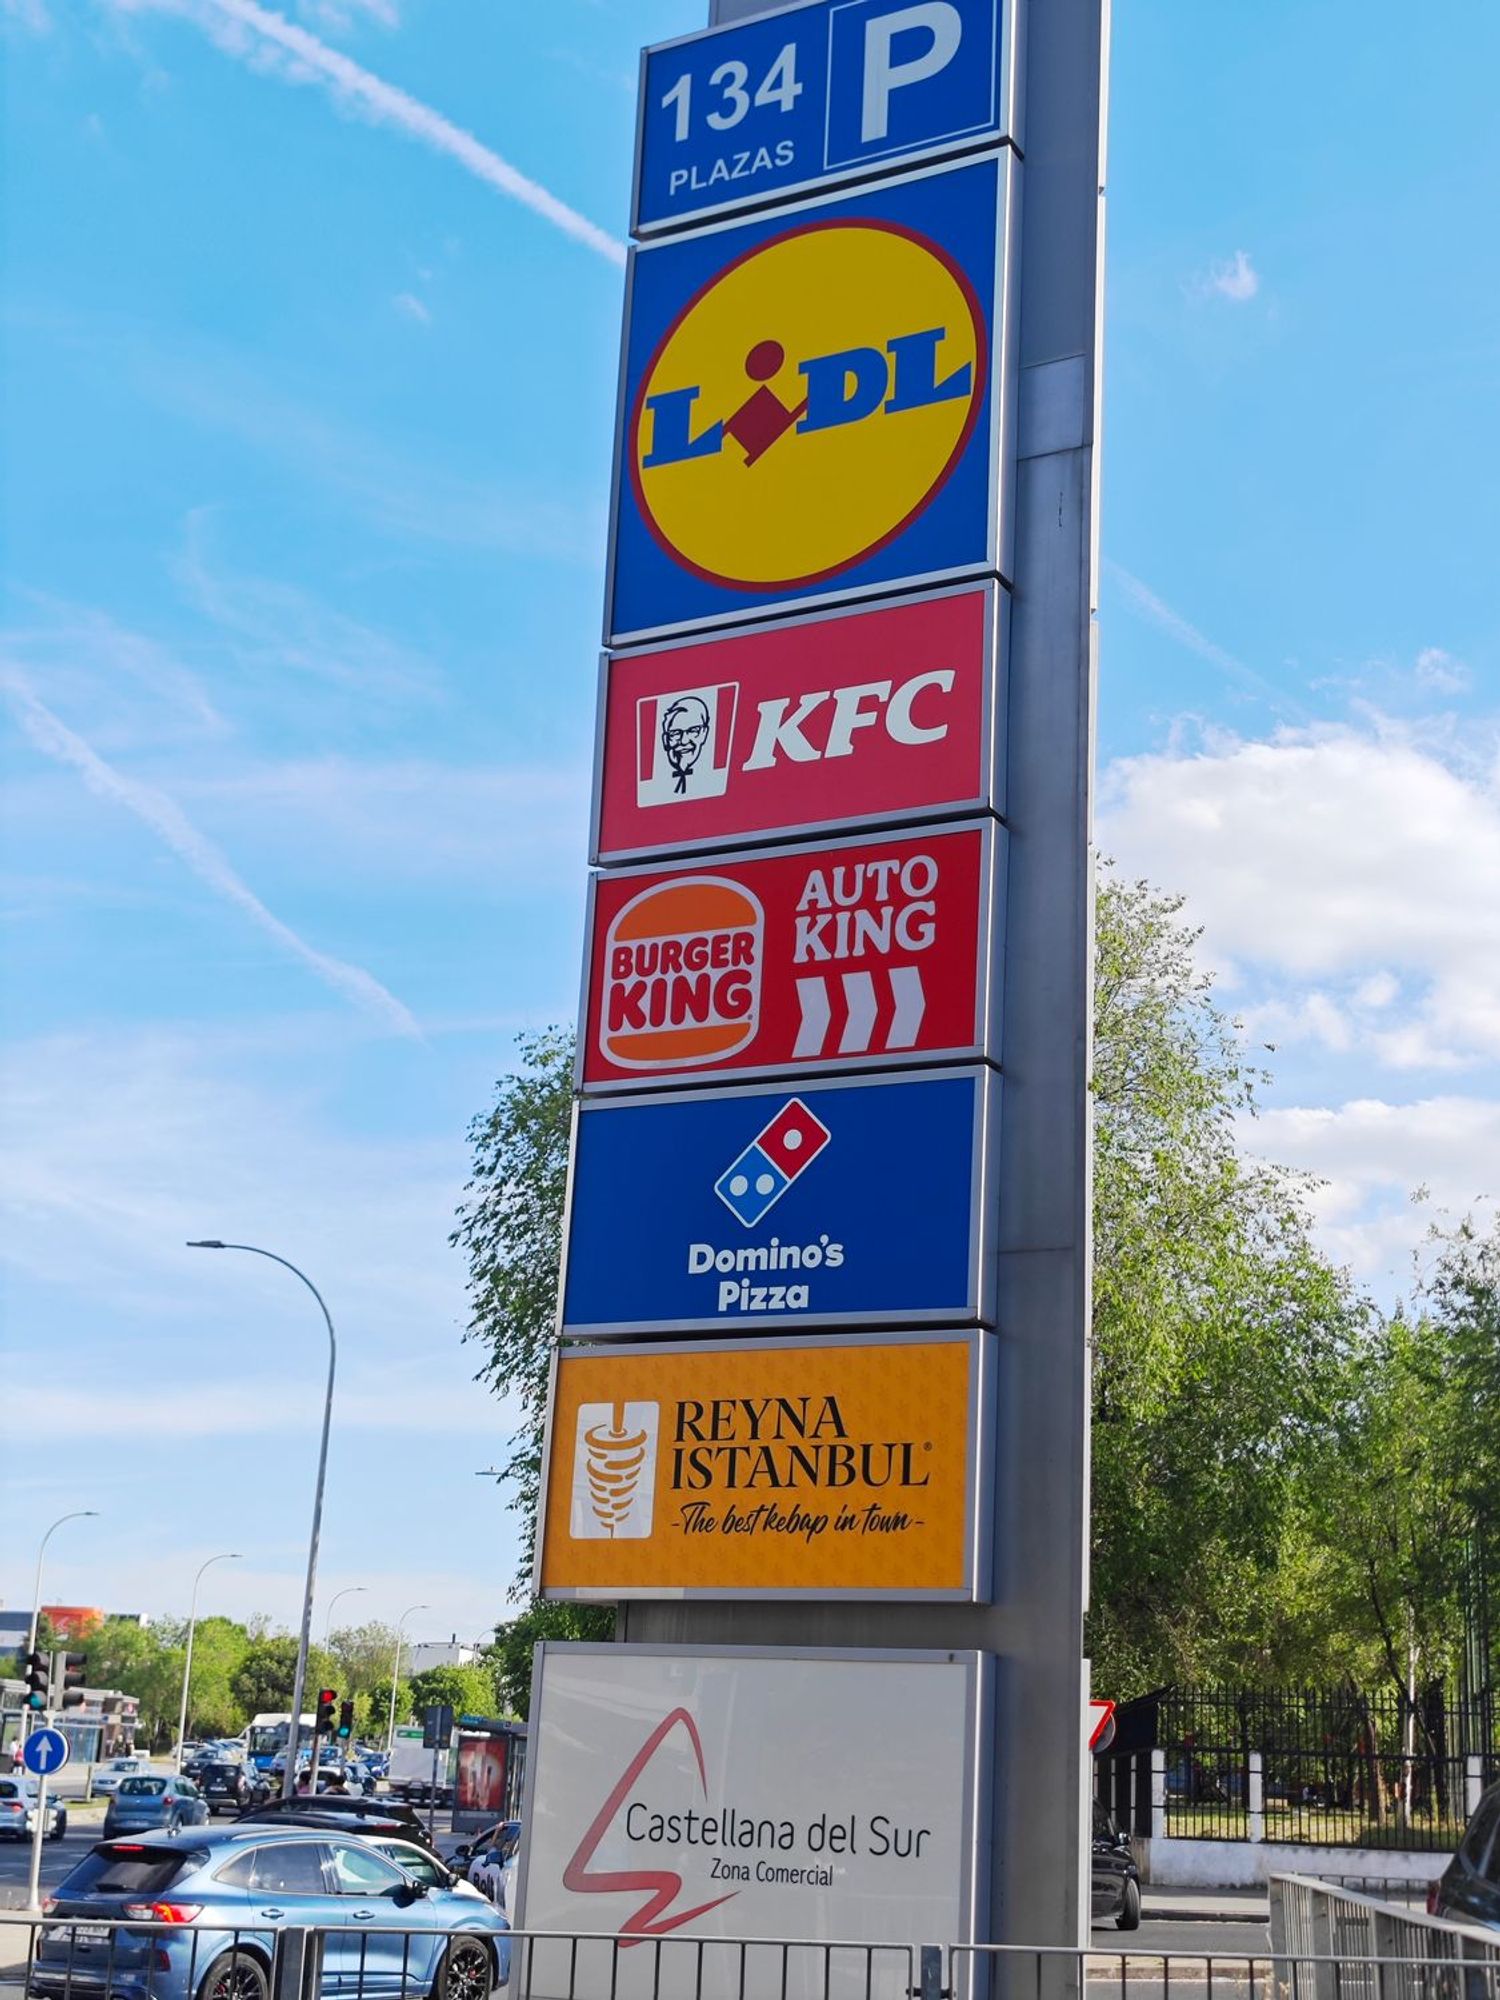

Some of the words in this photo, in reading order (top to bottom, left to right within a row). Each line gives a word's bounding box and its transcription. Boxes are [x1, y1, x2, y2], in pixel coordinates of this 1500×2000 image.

[661, 43, 802, 142] 134
[861, 1, 962, 143] P
[669, 141, 794, 195] PLAZAS
[742, 670, 955, 771] KFC
[795, 855, 938, 912] AUTO
[611, 932, 754, 980] BURGER
[793, 900, 936, 964] KING
[608, 970, 752, 1031] KING
[688, 1234, 844, 1274] Domino's
[718, 1278, 809, 1312] Pizza
[673, 1396, 848, 1442] REYNA
[722, 1503, 763, 1535] best
[765, 1502, 829, 1544] kebap
[834, 1503, 858, 1531] in
[626, 1803, 795, 1850] Castellana
[807, 1813, 856, 1854] del
[869, 1816, 931, 1858] Sur
[710, 1858, 750, 1882] Zona
[756, 1861, 833, 1886] Comercial
